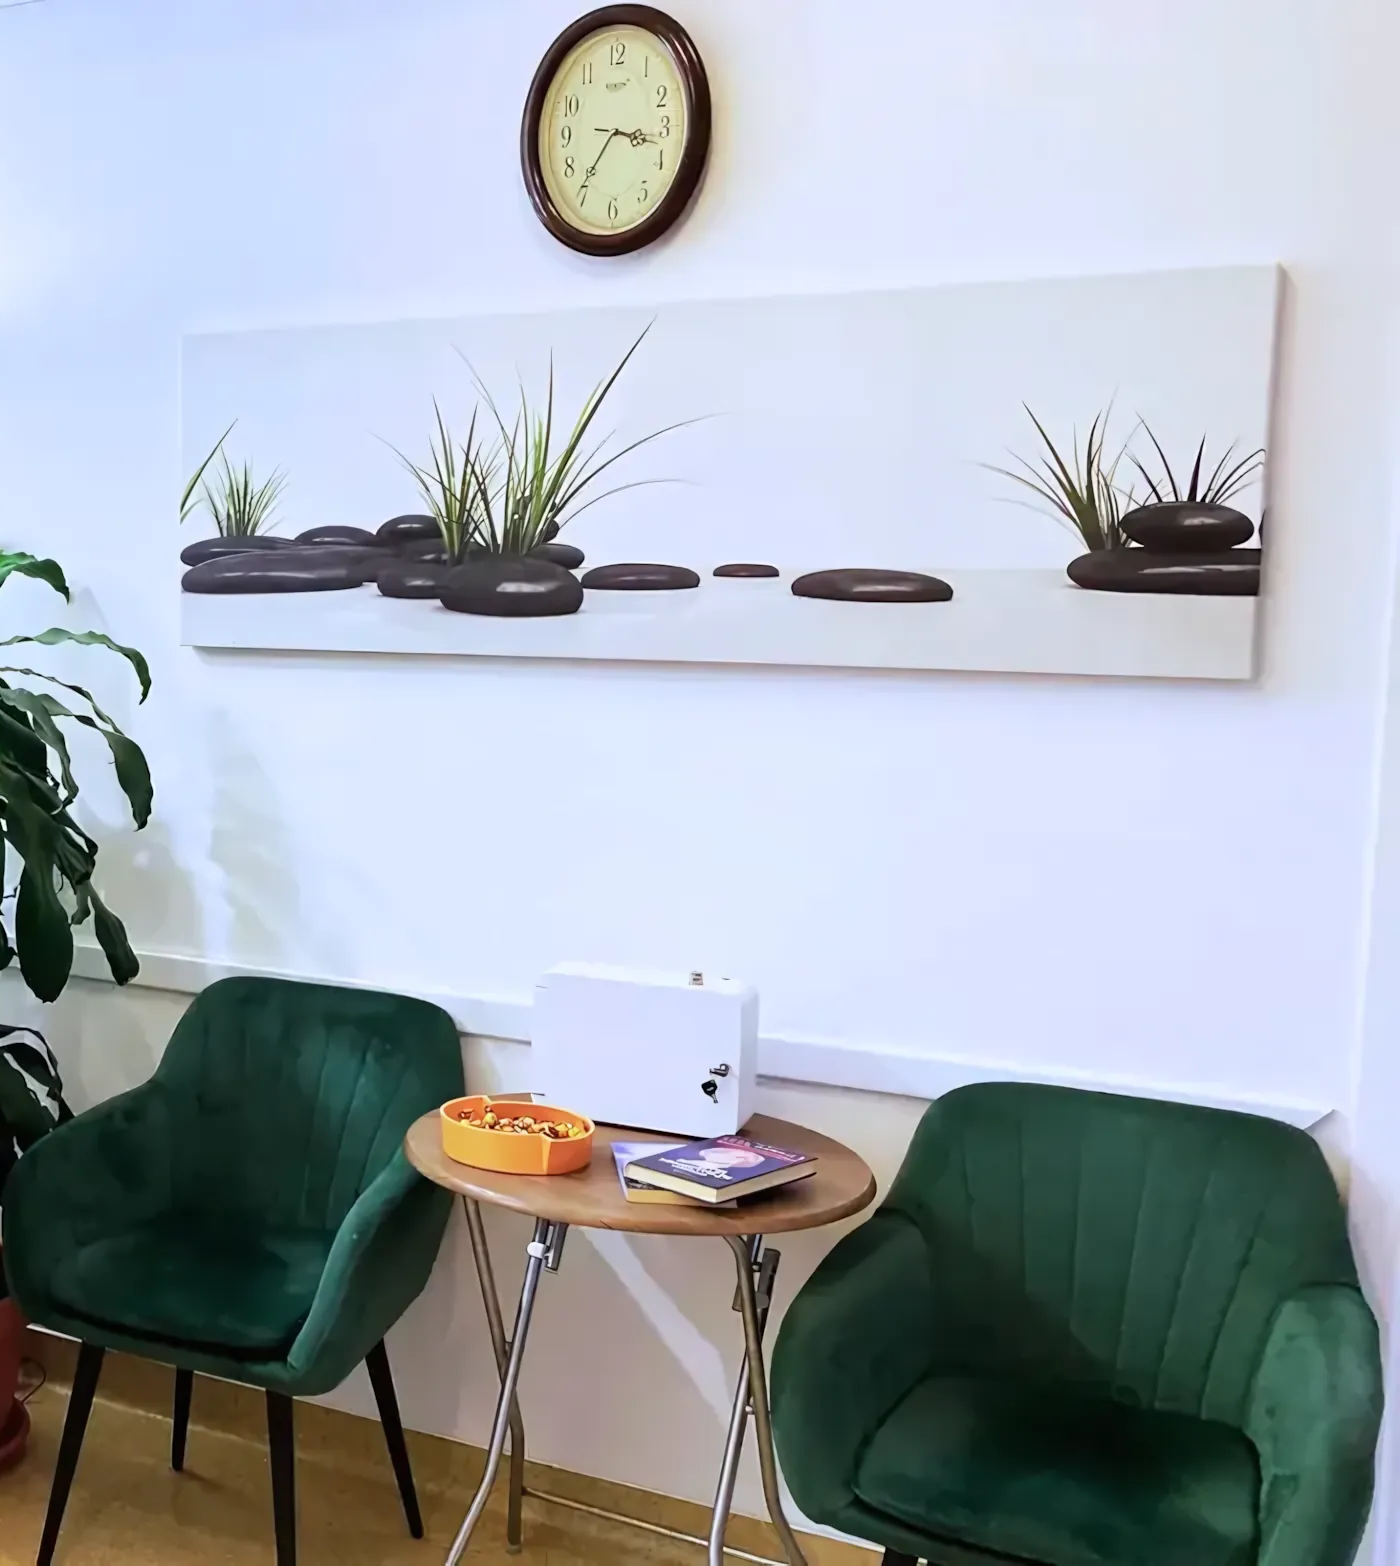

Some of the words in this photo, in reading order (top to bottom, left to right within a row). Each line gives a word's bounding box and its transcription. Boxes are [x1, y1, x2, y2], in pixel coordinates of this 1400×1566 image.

[609, 42, 626, 66] 12
[581, 62, 593, 85] 11
[643, 55, 648, 78] 1
[563, 94, 579, 118] 10
[656, 85, 668, 108] 2
[561, 125, 572, 149] 9
[659, 115, 670, 138] 3
[563, 155, 575, 178] 8
[579, 184, 589, 208] 7
[607, 197, 618, 220] 6
